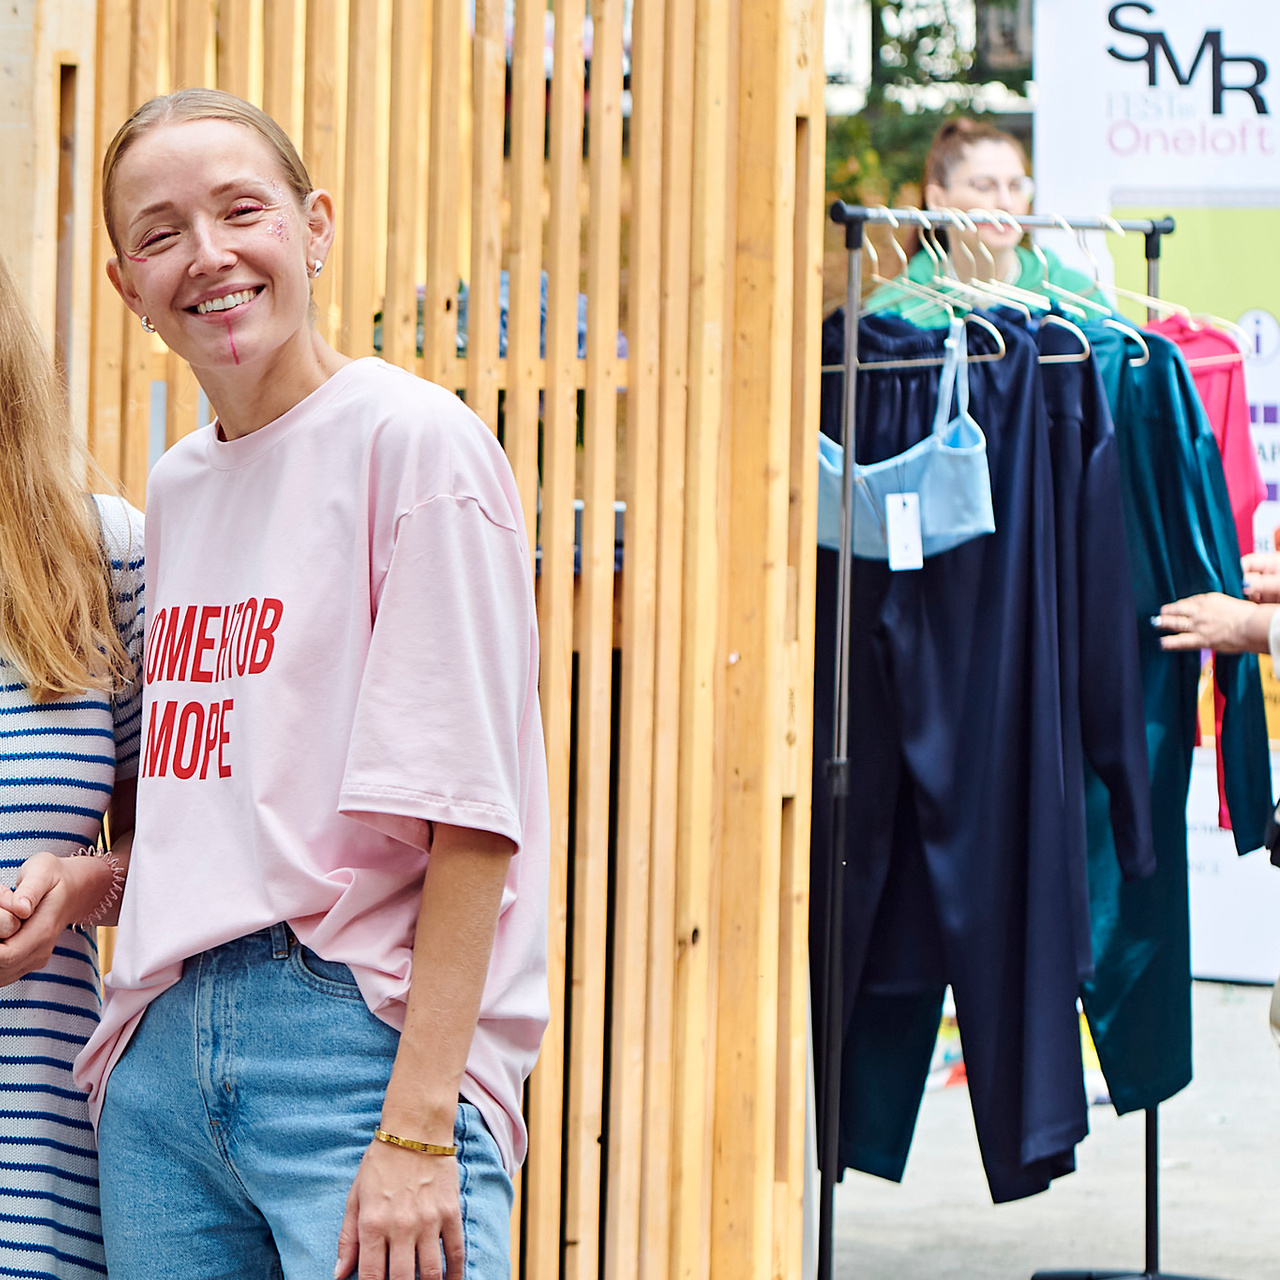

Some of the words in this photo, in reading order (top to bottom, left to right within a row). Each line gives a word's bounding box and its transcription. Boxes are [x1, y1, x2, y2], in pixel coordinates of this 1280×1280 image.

[1107, 2, 1269, 115] SMR
[1107, 117, 1275, 157] Oneloft
[145, 597, 284, 685] ОМЕНТОВ
[142, 699, 234, 780] МОРЕ
